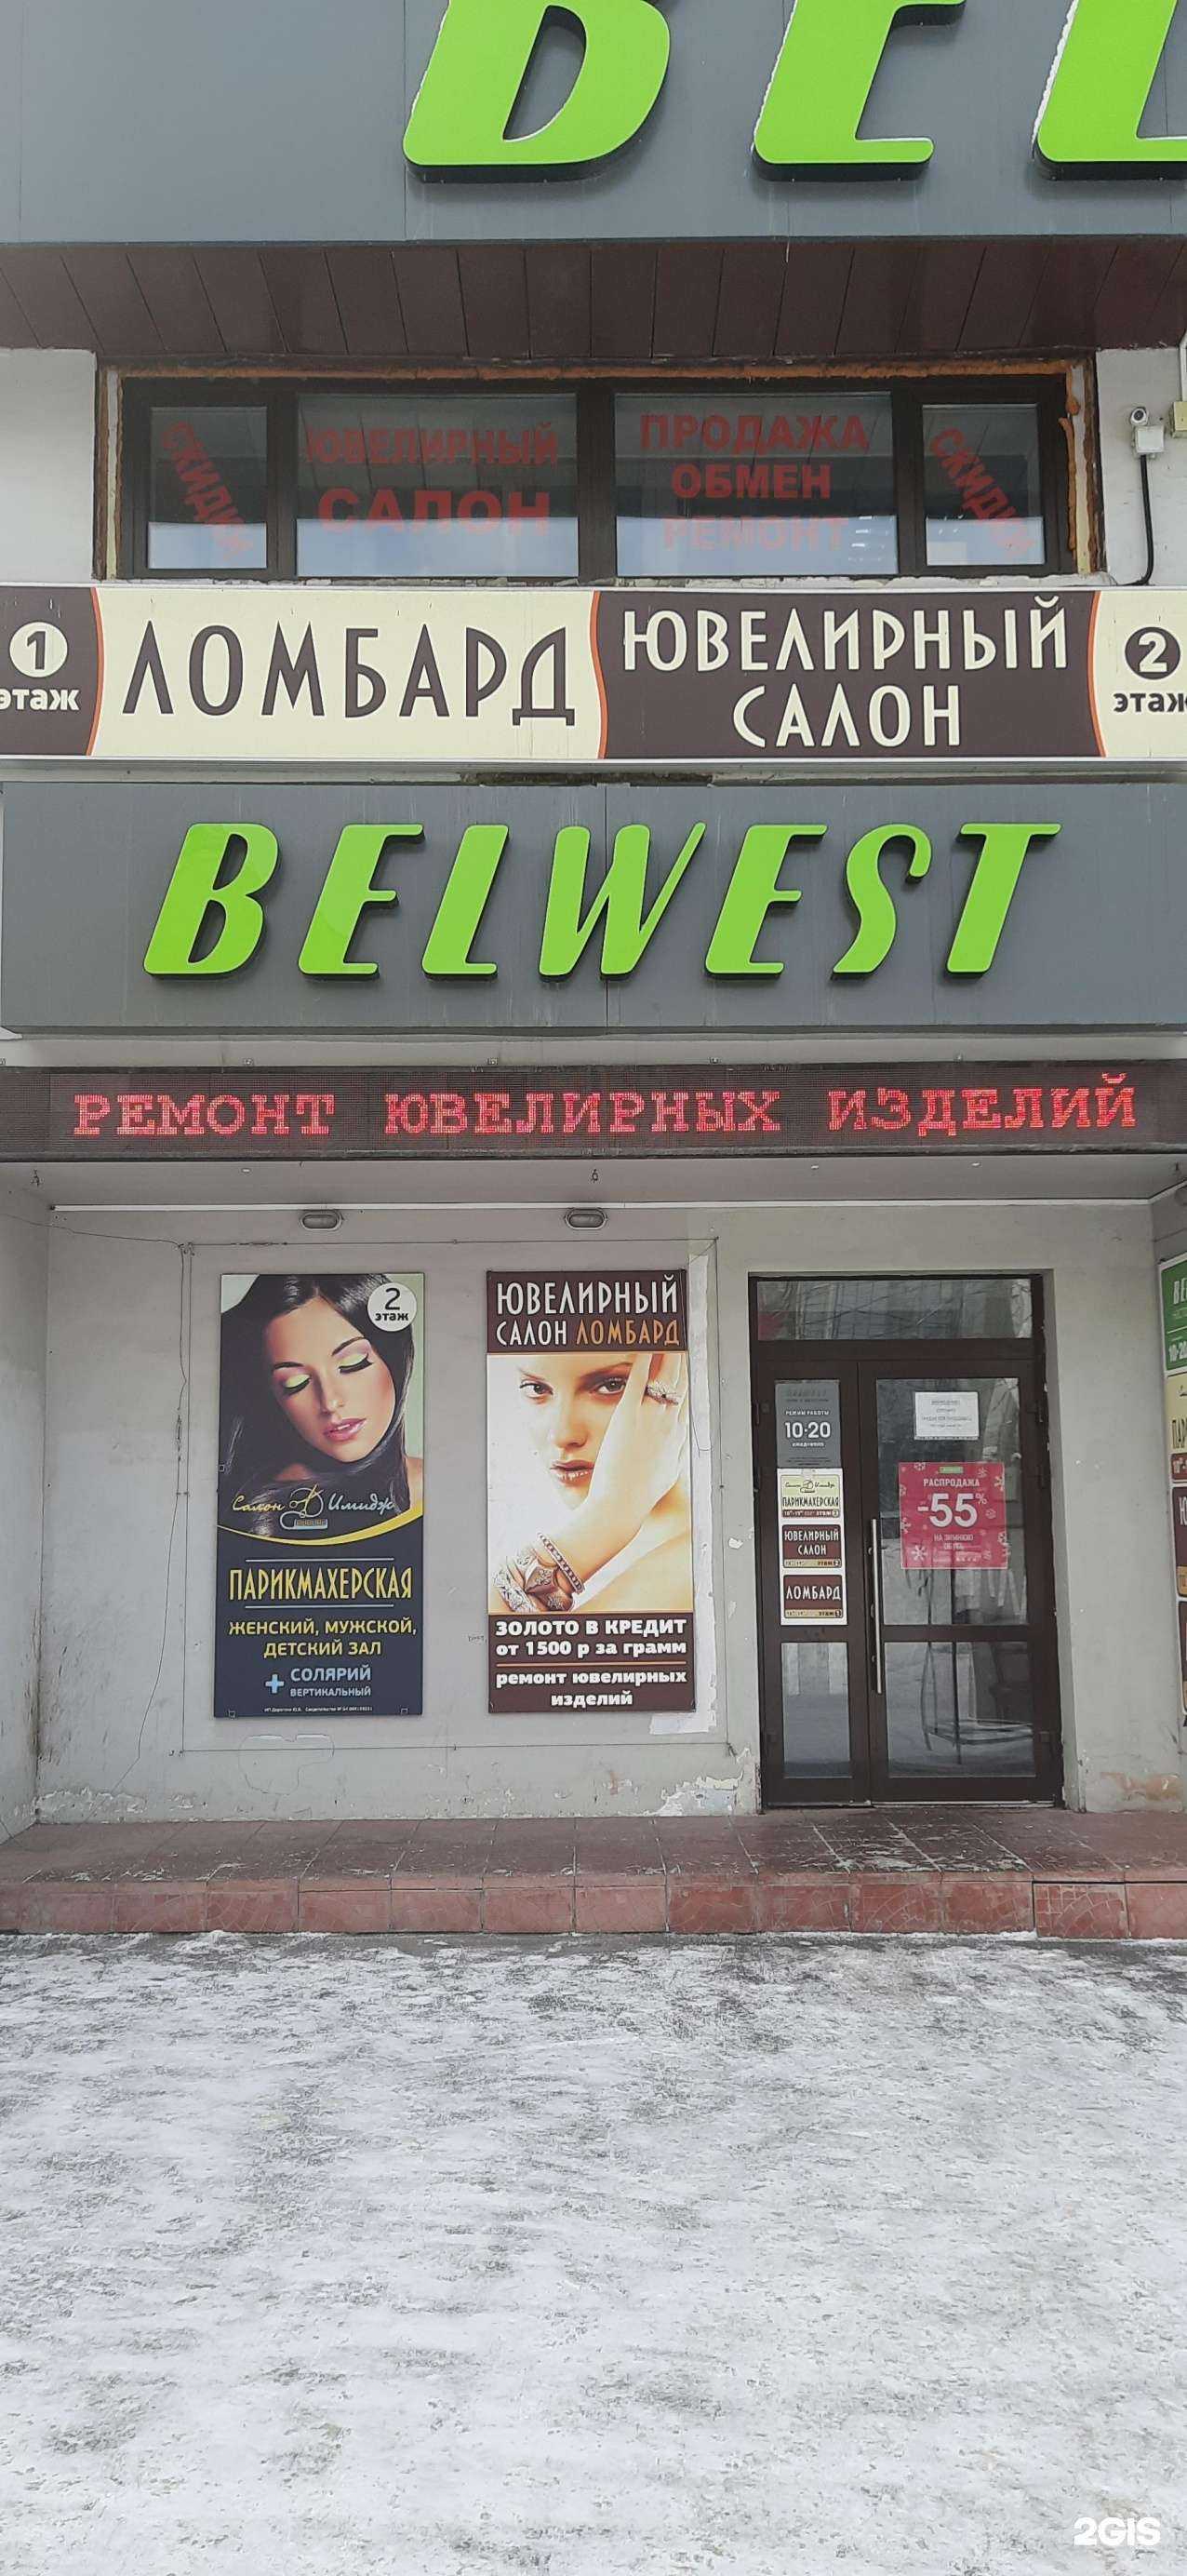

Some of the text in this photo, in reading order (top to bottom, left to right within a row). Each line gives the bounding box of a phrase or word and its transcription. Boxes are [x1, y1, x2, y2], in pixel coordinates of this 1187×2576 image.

[304, 423, 558, 464] ЮВЕЛИРНЫЙ
[639, 414, 870, 456] ПРОДАЖА
[162, 420, 254, 561] СКИДКИ
[672, 464, 831, 500] ОБМЕН
[931, 426, 1035, 559] СКИДКИ
[318, 487, 550, 537] САЛОН
[662, 517, 847, 551] РЕМОНТ
[624, 596, 1067, 671] ЮВЕЛИРНЫЙ
[27, 631, 46, 670] 1
[1138, 632, 1167, 672] 2
[122, 620, 575, 726] ЛОМБАРД
[0, 689, 80, 711] этаж
[733, 683, 960, 748] САЛОН
[142, 823, 1062, 979] BELWEST
[73, 1072, 1137, 1137] РЕМОНТ ЮВЕЛИРНЫХ ИЗДЕЛИЙ
[385, 1288, 401, 1310] 2
[497, 1274, 678, 1315] ЮВЕЛИРНЫЙ
[375, 1313, 409, 1322] этаж
[496, 1319, 680, 1346] САЛОН ЛОМБАРД
[923, 1478, 980, 1487] РАСПРОДАЖА
[782, 1496, 839, 1507] ПАРИКМАХЕРСКАЯ
[784, 1529, 839, 1541] ЮВЕЛИРНЫЙ
[797, 1545, 827, 1555] САЛОН
[229, 1566, 412, 1601] ПАРИКМАХЕРСКАЯ
[786, 1586, 841, 1600] ЛОМБАРД
[229, 1617, 417, 1636] ЖЕНСКИЙ, МУЖСКОЙ,
[495, 1619, 687, 1637] ЗОЛОТО В КРЕДИТ
[263, 1639, 381, 1658] ДЕТСКИЙ ЗАЛ
[496, 1641, 687, 1658] от 1500 р за грамм
[290, 1665, 371, 1681] СОЛЯРИЙ
[496, 1670, 687, 1688] ремонт ювелирных
[290, 1686, 371, 1697] ВЕРТИКАЛЬНЫЙ
[551, 1690, 634, 1708] изделий
